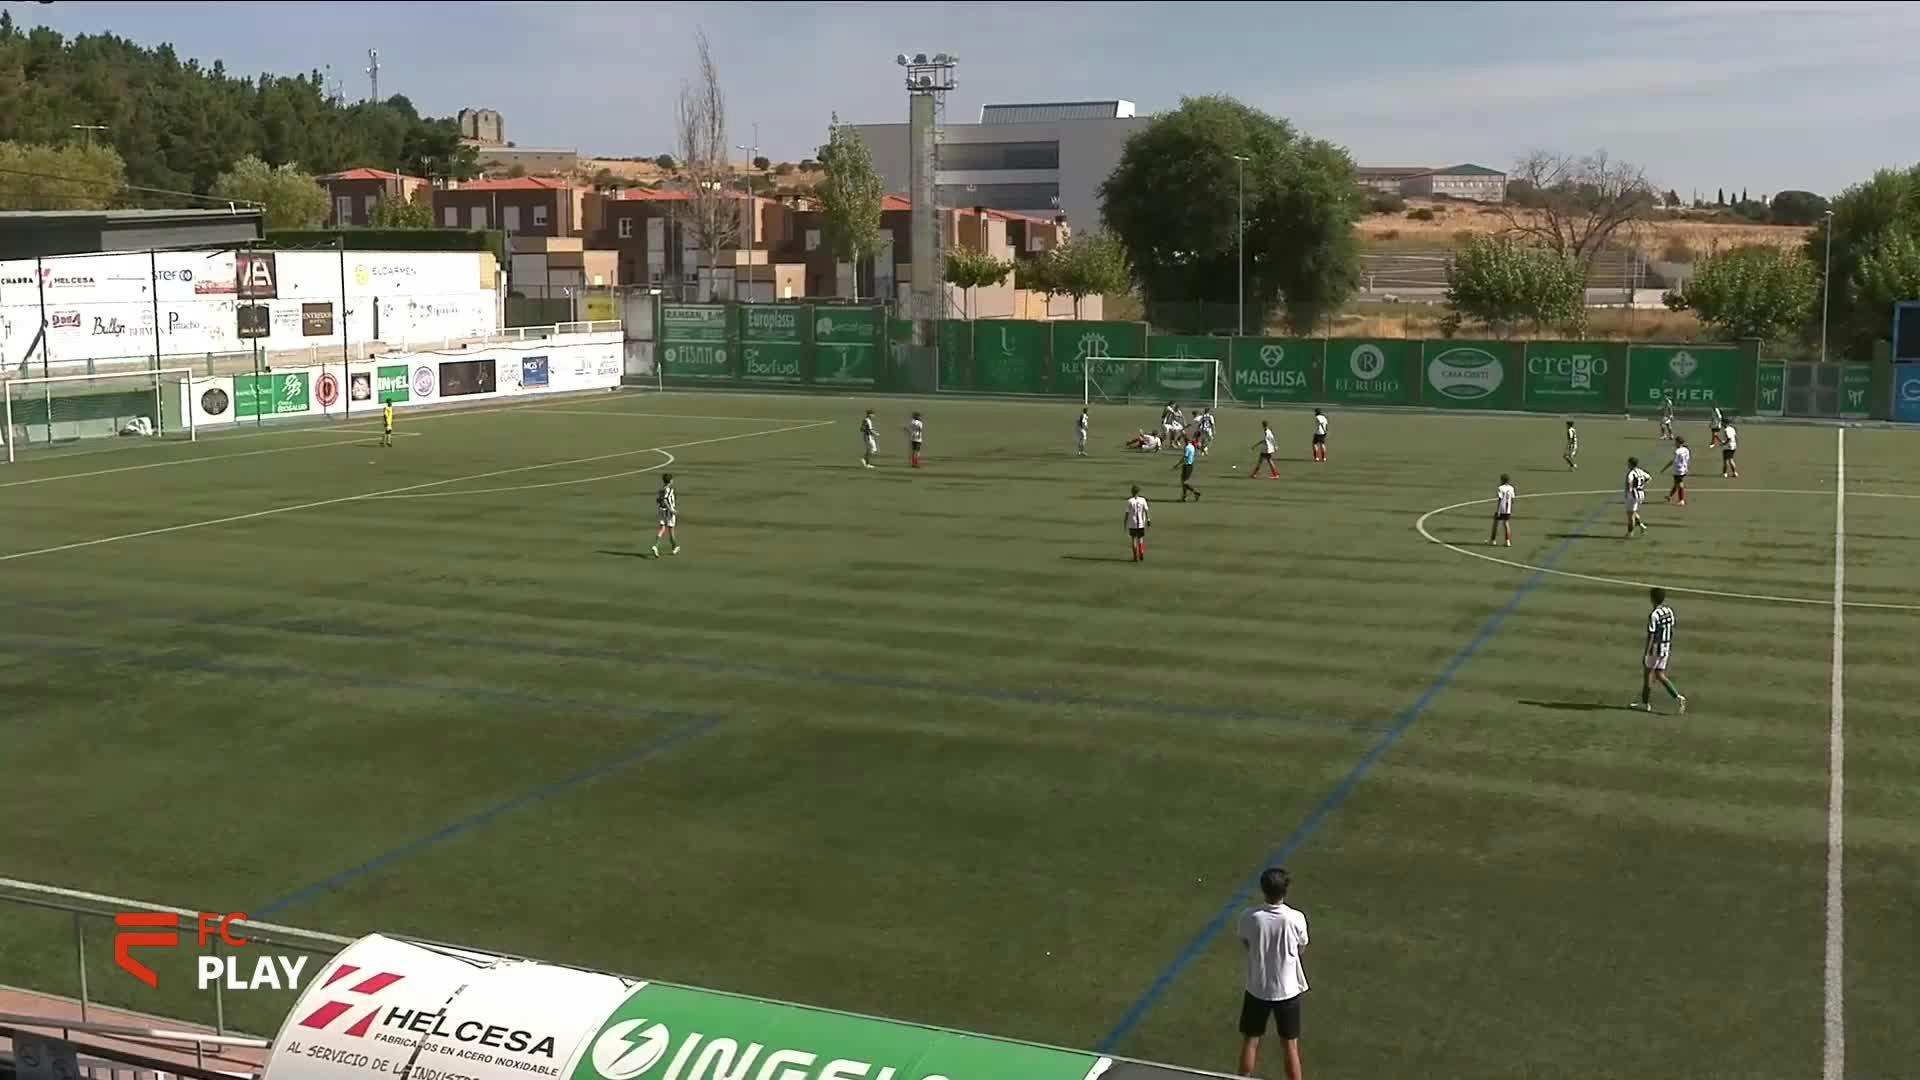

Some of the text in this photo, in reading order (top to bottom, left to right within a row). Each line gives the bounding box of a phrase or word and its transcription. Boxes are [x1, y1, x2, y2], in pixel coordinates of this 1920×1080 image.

[1235, 370, 1307, 387] MAGUISA
[1335, 378, 1399, 392] EL RUBIO
[383, 1006, 556, 1058] HELCESA
[287, 1041, 302, 1055] AL
[307, 1045, 369, 1068] SERVICIO
[371, 1058, 389, 1073] DE
[374, 1033, 559, 1077] FABRICAOS EN ACERO INOXIDABLE
